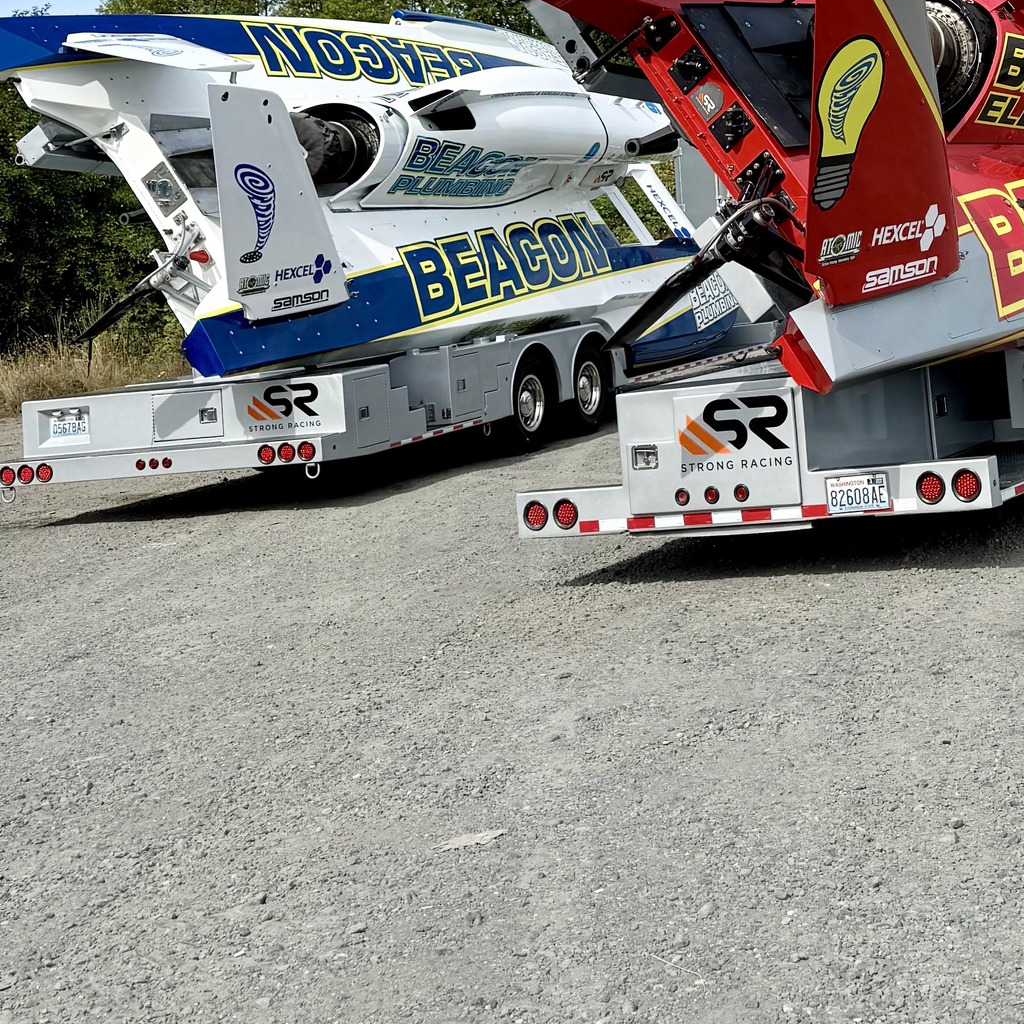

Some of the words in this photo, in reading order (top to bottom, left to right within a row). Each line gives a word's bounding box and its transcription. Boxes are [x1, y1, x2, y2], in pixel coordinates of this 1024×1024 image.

[387, 174, 515, 197] PLUMBING
[646, 184, 680, 228] HEXCEL
[871, 220, 924, 247] HEXCEL
[274, 264, 314, 282] HEXCEL
[396, 212, 612, 322] BEACON
[689, 272, 730, 310] BEACO
[263, 383, 320, 417] SR
[248, 424, 284, 433] STRONG
[288, 420, 321, 429] RACING
[703, 395, 790, 450] SR
[681, 460, 734, 473] STRONG
[741, 456, 793, 469] RACING
[829, 479, 865, 488] WASHINGTON
[830, 486, 887, 508] 82608AE
